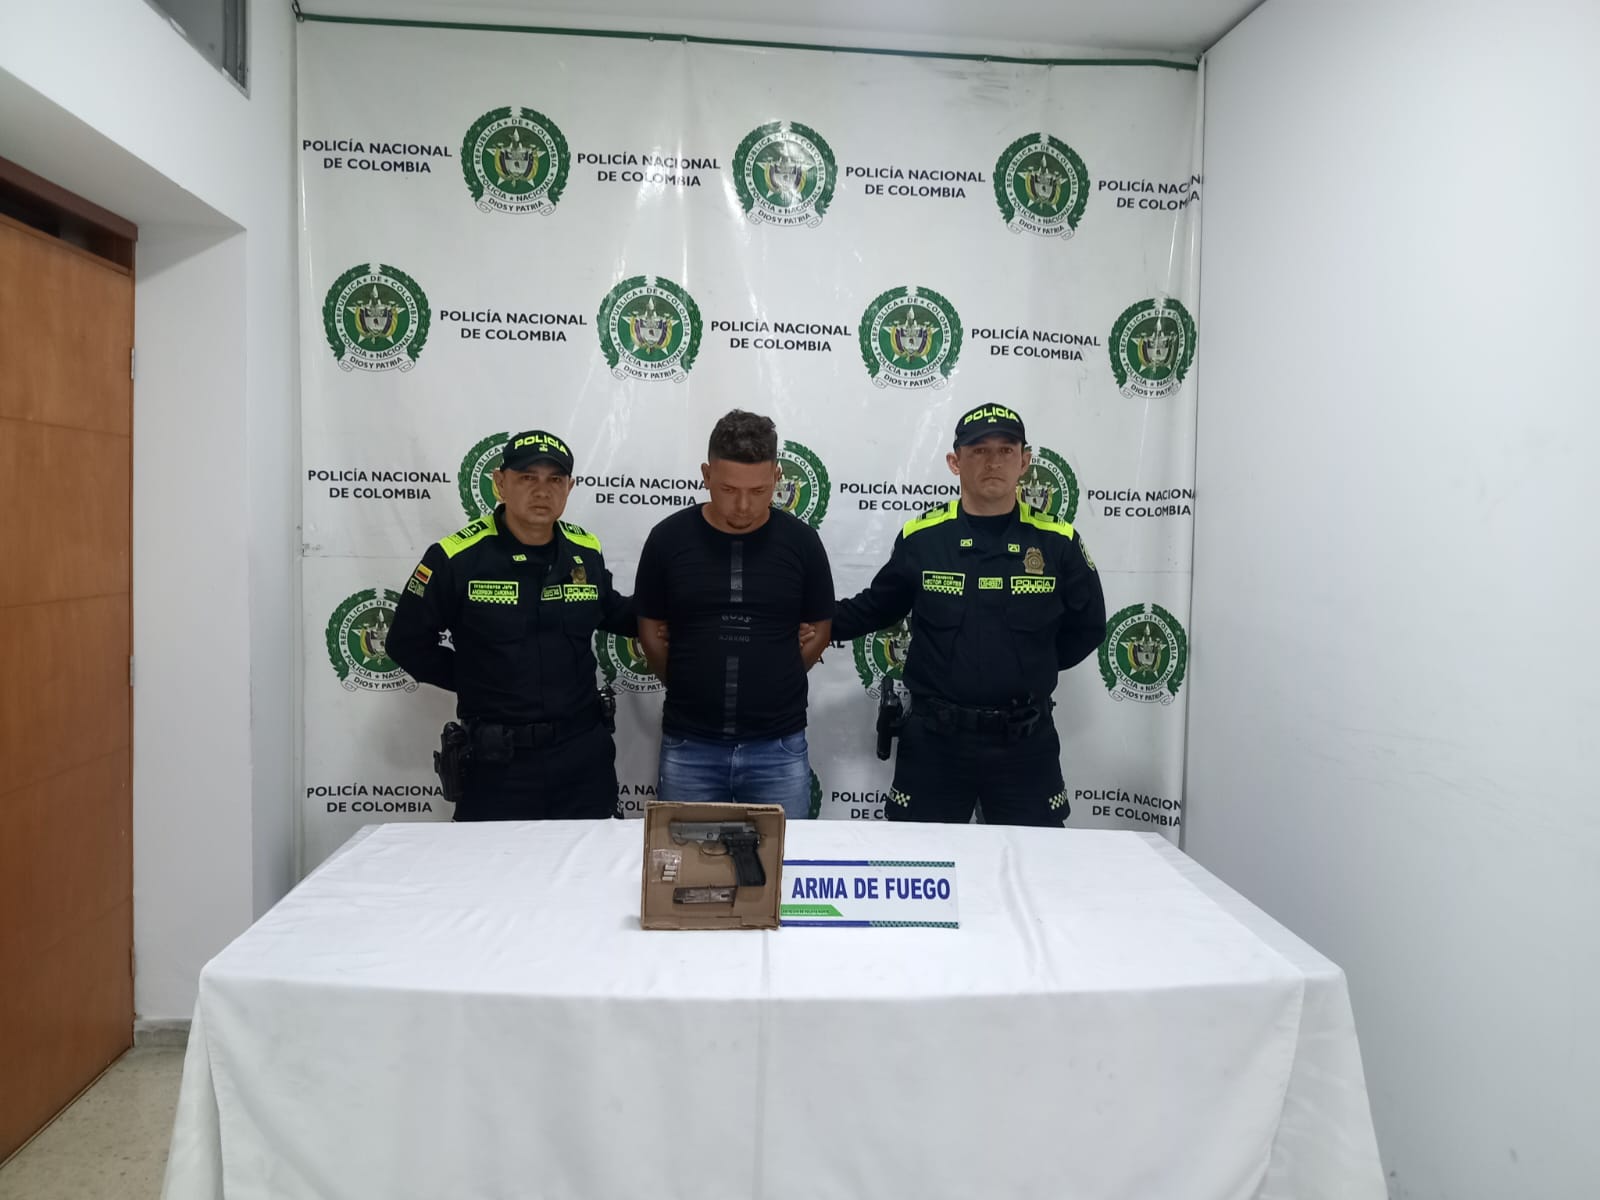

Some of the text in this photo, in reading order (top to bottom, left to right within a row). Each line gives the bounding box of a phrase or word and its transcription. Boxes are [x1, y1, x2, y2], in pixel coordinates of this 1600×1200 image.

[303, 138, 452, 158] POLICÍA NACIONAL
[324, 156, 431, 173] DE COLOMBIA
[577, 152, 721, 169] POLICÍA NACIONAL
[598, 171, 701, 187] DE COLOMBIA
[846, 166, 986, 183] POLICÍA NACIONAL
[865, 184, 966, 198] DE COLOMBIA
[1099, 179, 1154, 193] POLICÍA
[1116, 197, 1135, 208] DE
[440, 309, 588, 326] POLICÍA NACIONAL
[711, 318, 852, 336] POLICÍA NACIONAL
[461, 328, 567, 342] DE COLOMBIA
[972, 327, 1101, 346] POLICÍA NACIONAL
[730, 338, 832, 352] DE COLOMBIA
[990, 345, 1083, 361] DE COLOMBIA
[308, 468, 451, 484] POLICÍA NACIONAL
[575, 474, 705, 490] POLICÍA NACIONA
[329, 487, 431, 500] DE COLOMBIA
[840, 481, 960, 496] POLICÍA NACION
[1088, 488, 1141, 502] POLICÍA
[596, 493, 696, 506] DE COLOMBIA
[859, 500, 940, 511] DE COLOM
[1104, 505, 1191, 518] DE COLOMBIA
[307, 783, 443, 798] POLICÍA NACIONA
[832, 790, 888, 804] POLICÍA
[327, 801, 432, 813] DE COLOMBIA
[1075, 789, 1181, 810] POLICÍA NACION
[1093, 805, 1181, 827] DE COLOMBIA
[792, 877, 951, 900] ARMA DE FUEGO
